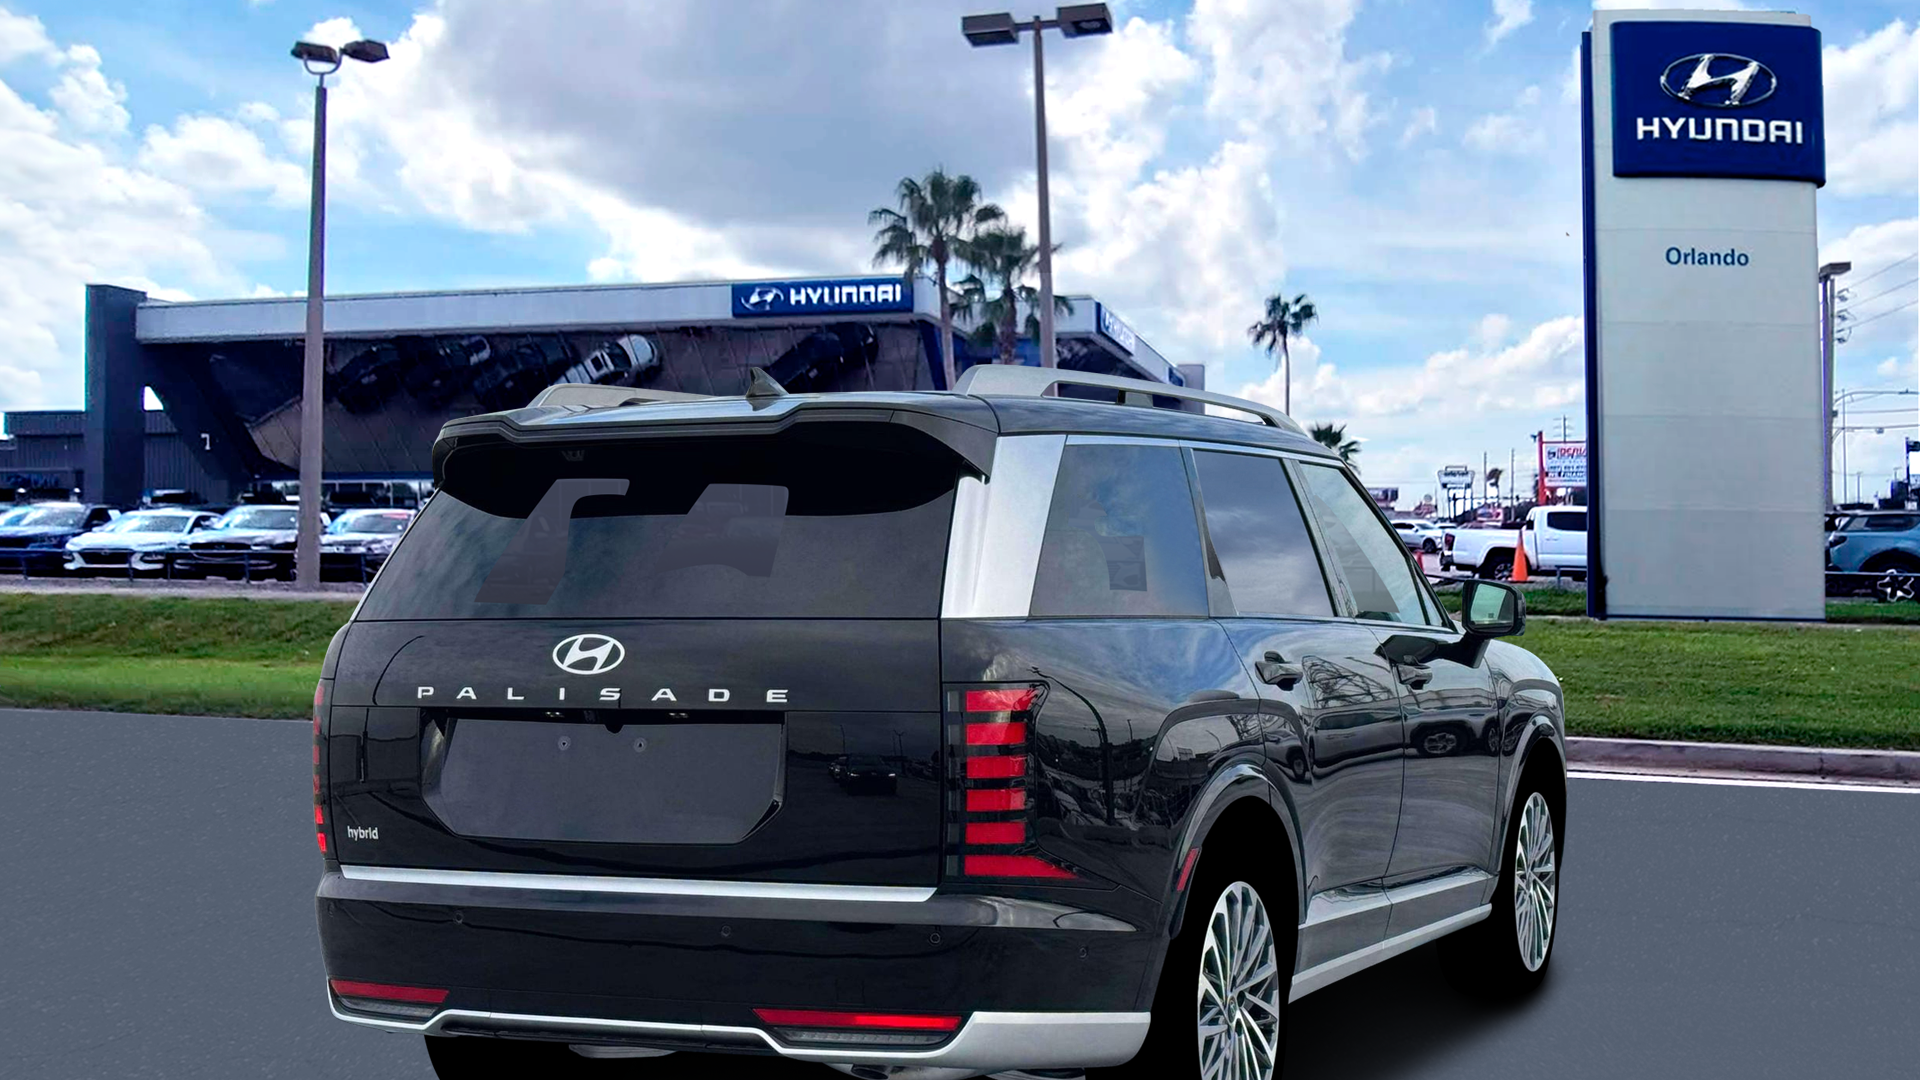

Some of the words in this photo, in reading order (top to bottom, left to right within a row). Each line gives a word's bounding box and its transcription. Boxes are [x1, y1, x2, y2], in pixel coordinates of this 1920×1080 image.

[1636, 117, 1804, 144] HYUNDAI
[1665, 247, 1750, 266] Orlando
[789, 283, 902, 306] HYUNDAI
[416, 686, 790, 703] PALISADE
[346, 825, 380, 842] hybrid
